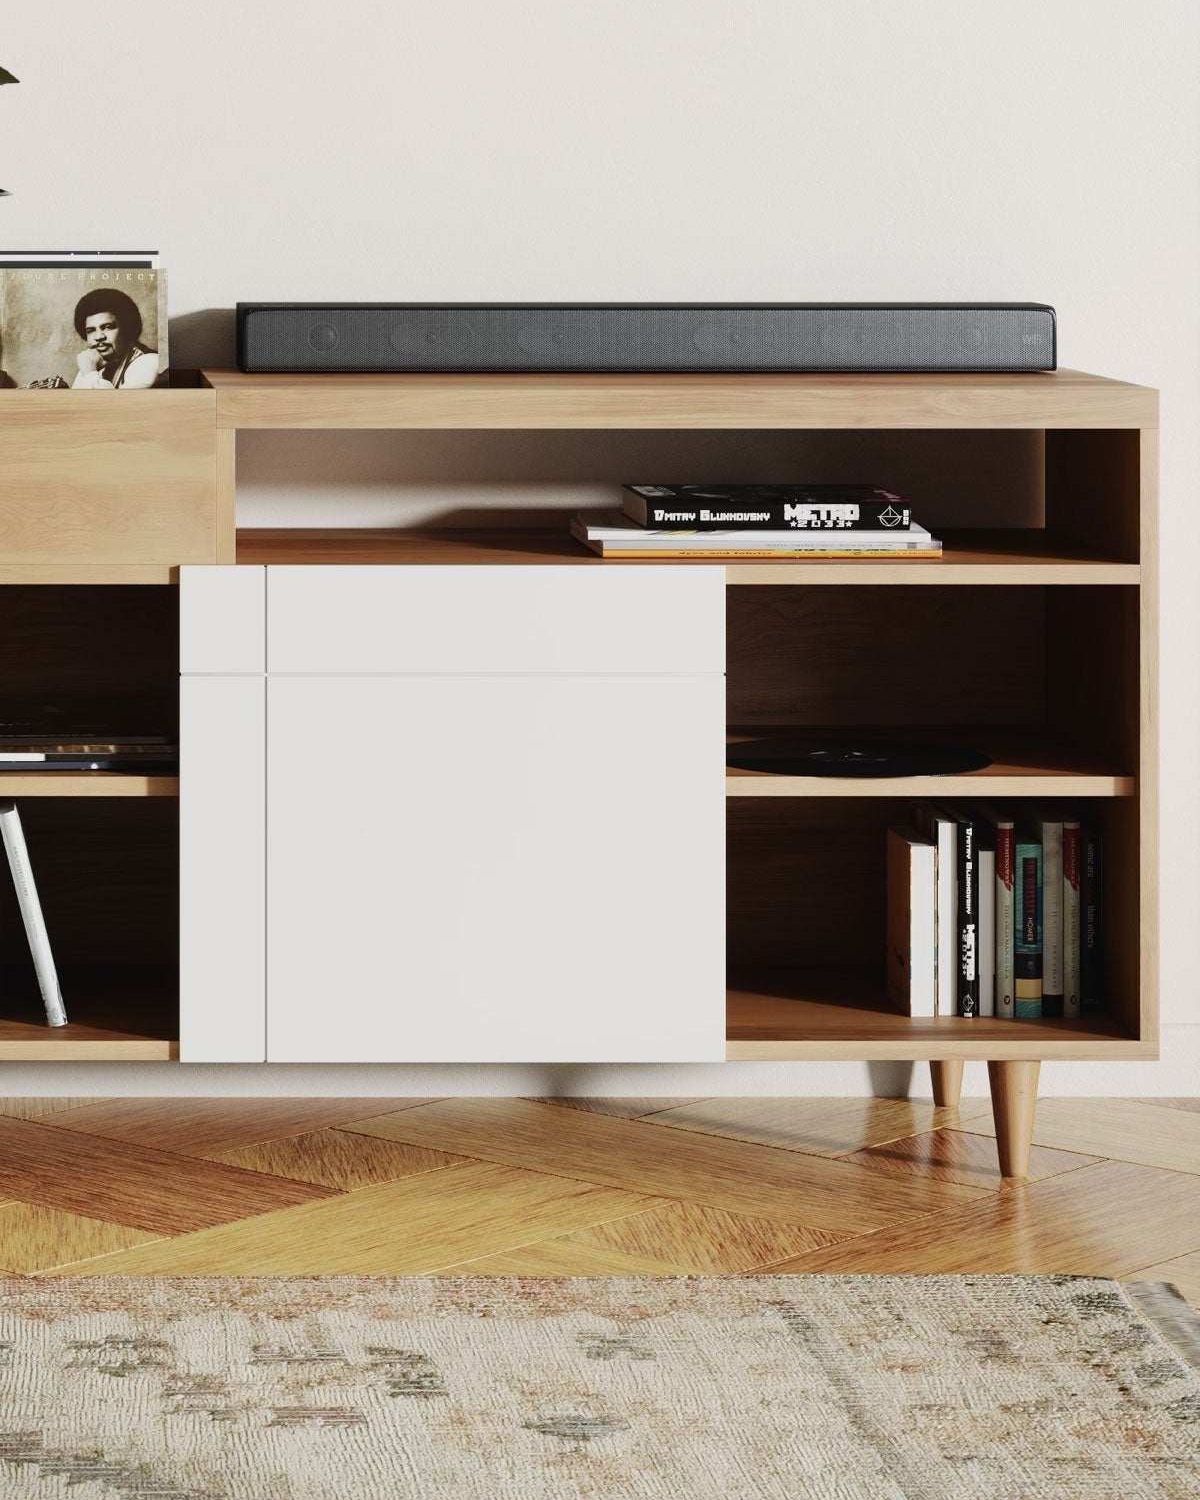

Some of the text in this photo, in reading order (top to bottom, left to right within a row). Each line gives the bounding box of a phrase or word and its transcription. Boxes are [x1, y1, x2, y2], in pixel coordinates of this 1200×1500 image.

[78, 272, 158, 282] PROJECT
[653, 509, 697, 522] DMITRY
[783, 503, 860, 521] METRO
